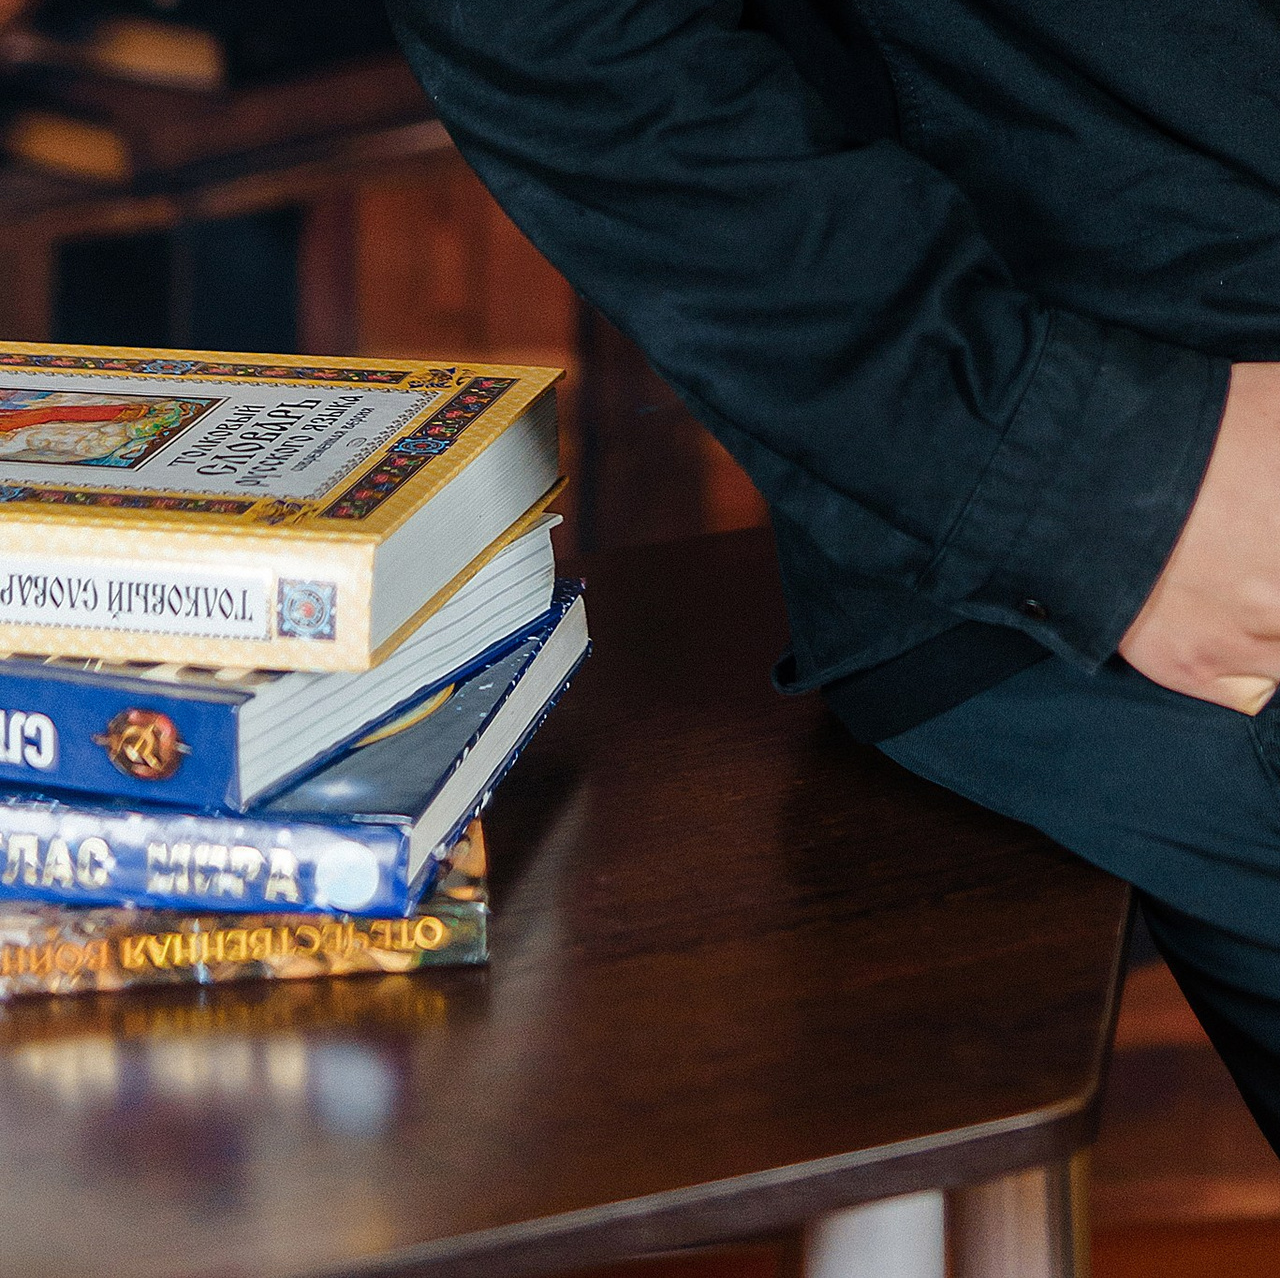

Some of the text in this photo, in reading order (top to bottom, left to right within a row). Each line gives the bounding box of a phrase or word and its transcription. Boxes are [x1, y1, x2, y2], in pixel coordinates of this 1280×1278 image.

[197, 399, 322, 476] СЛОВАРЬ
[106, 579, 253, 621] ТОЛКОВЫЙ
[146, 842, 300, 903] МИРА
[123, 915, 444, 970] ОТЕЧЕСТВЕННАЯ
